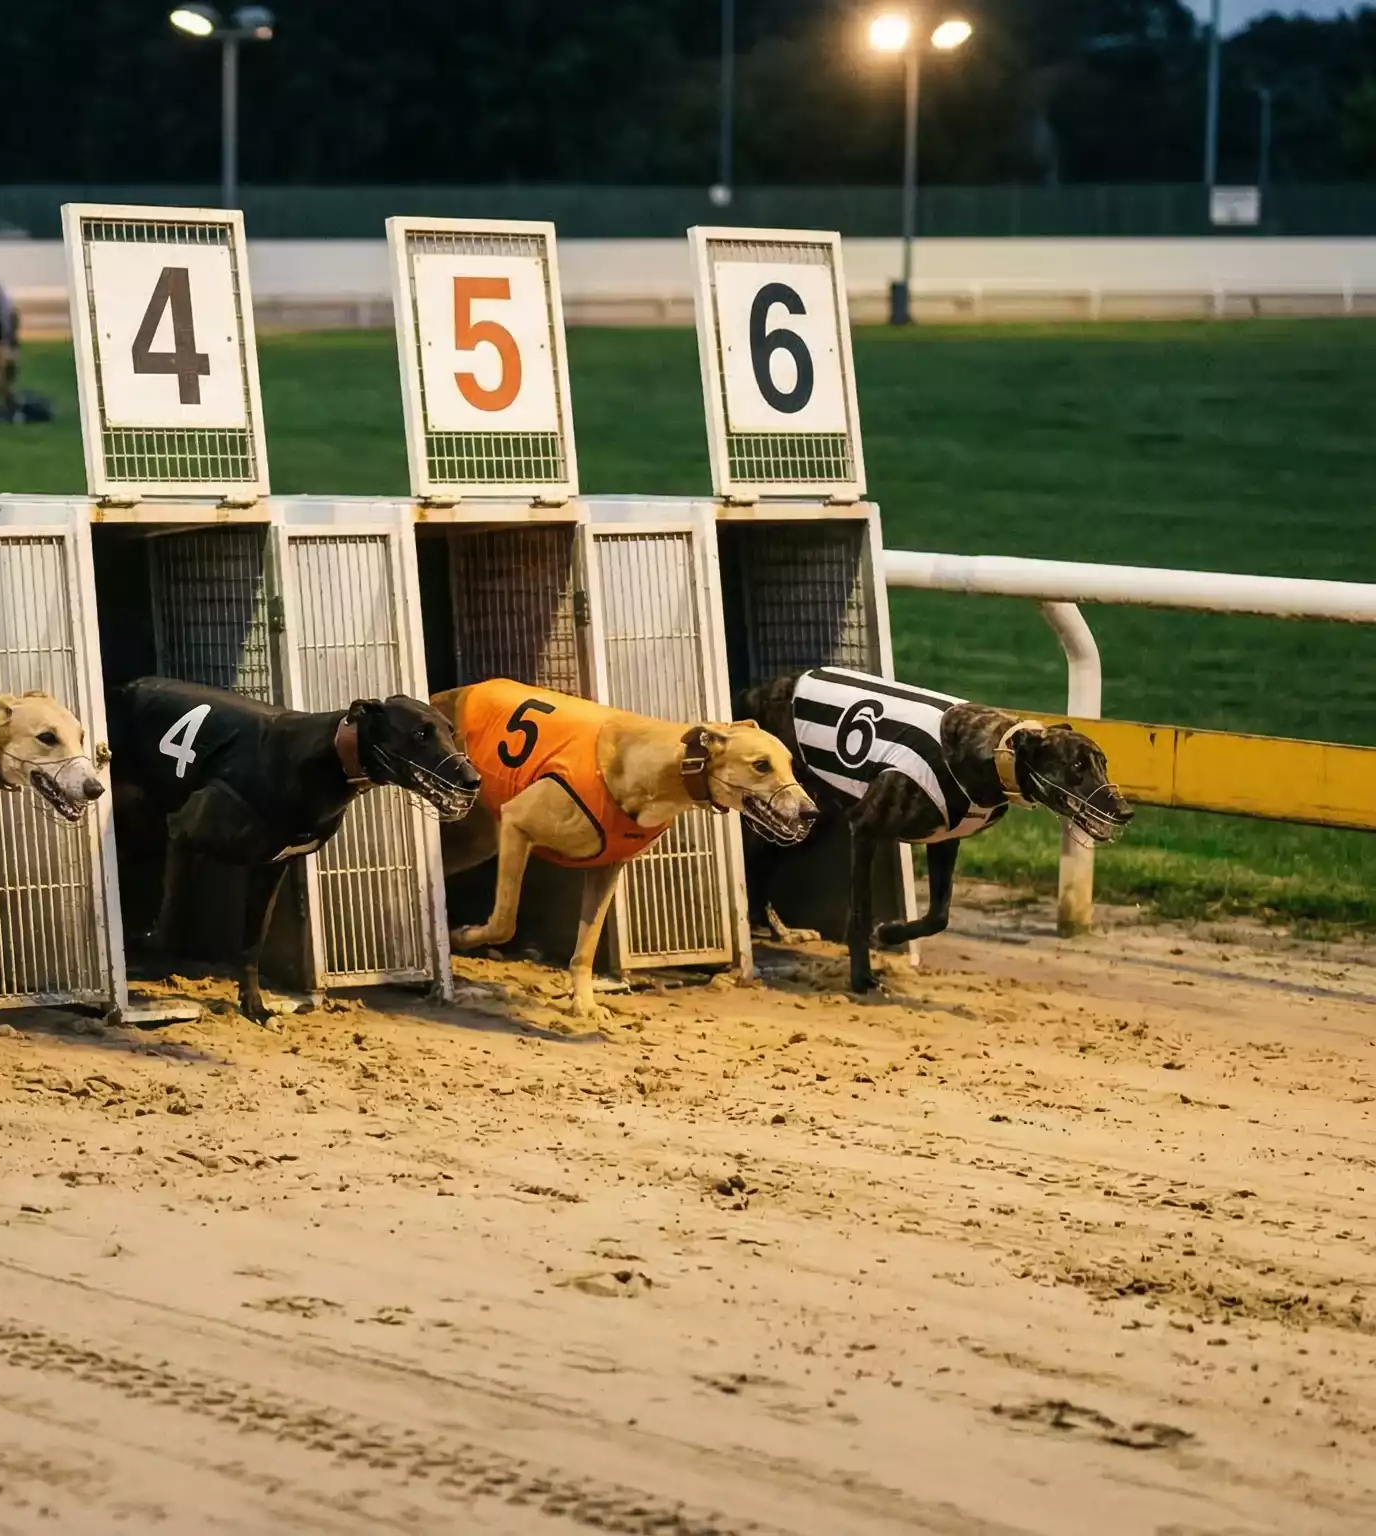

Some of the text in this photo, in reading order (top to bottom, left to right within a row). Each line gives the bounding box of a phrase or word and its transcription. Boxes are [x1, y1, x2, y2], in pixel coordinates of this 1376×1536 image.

[131, 266, 211, 405] 4
[453, 276, 522, 412] 5
[749, 282, 814, 414] 6
[159, 704, 212, 778] 4
[497, 699, 556, 768] 5
[836, 699, 883, 767] 6
